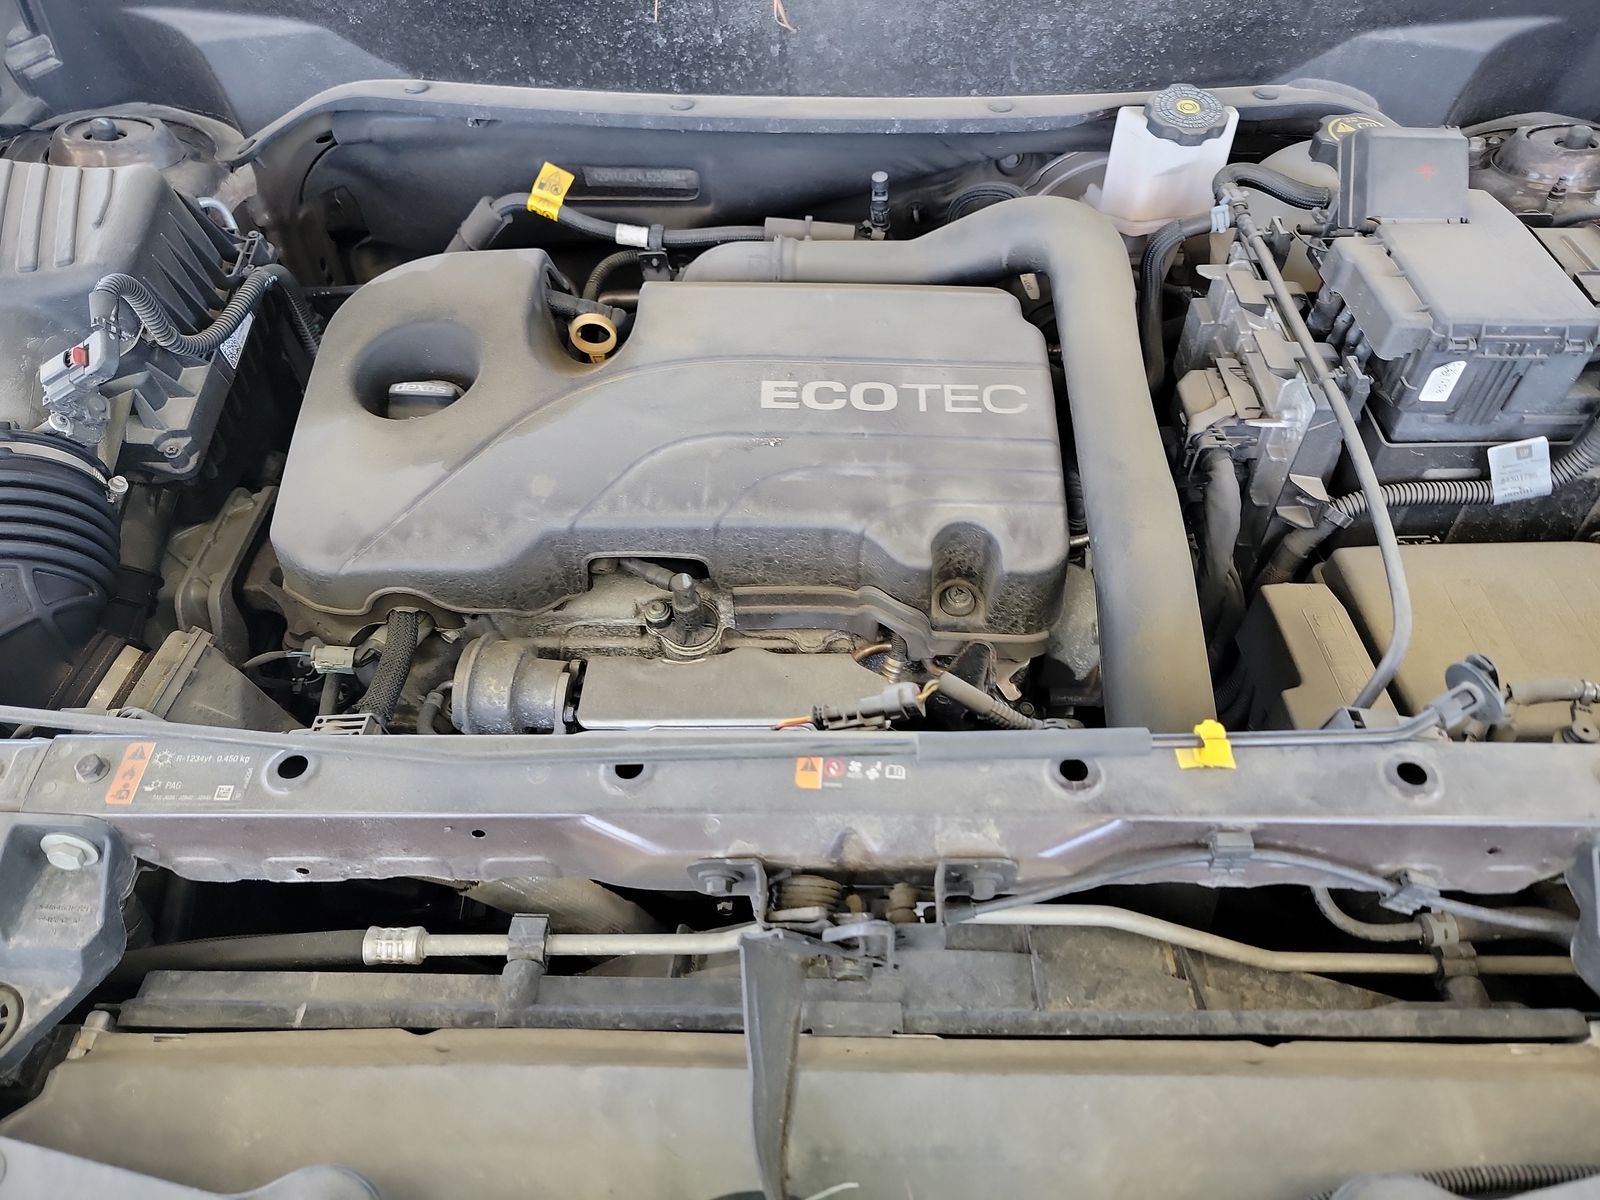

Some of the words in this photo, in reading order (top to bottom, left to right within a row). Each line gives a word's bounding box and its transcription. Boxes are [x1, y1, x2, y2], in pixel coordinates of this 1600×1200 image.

[395, 383, 447, 393] dexos
[759, 380, 1029, 414] ECOTEC
[176, 755, 212, 763] R-1234yf
[216, 755, 239, 763] 0.450
[165, 781, 182, 790] PAG
